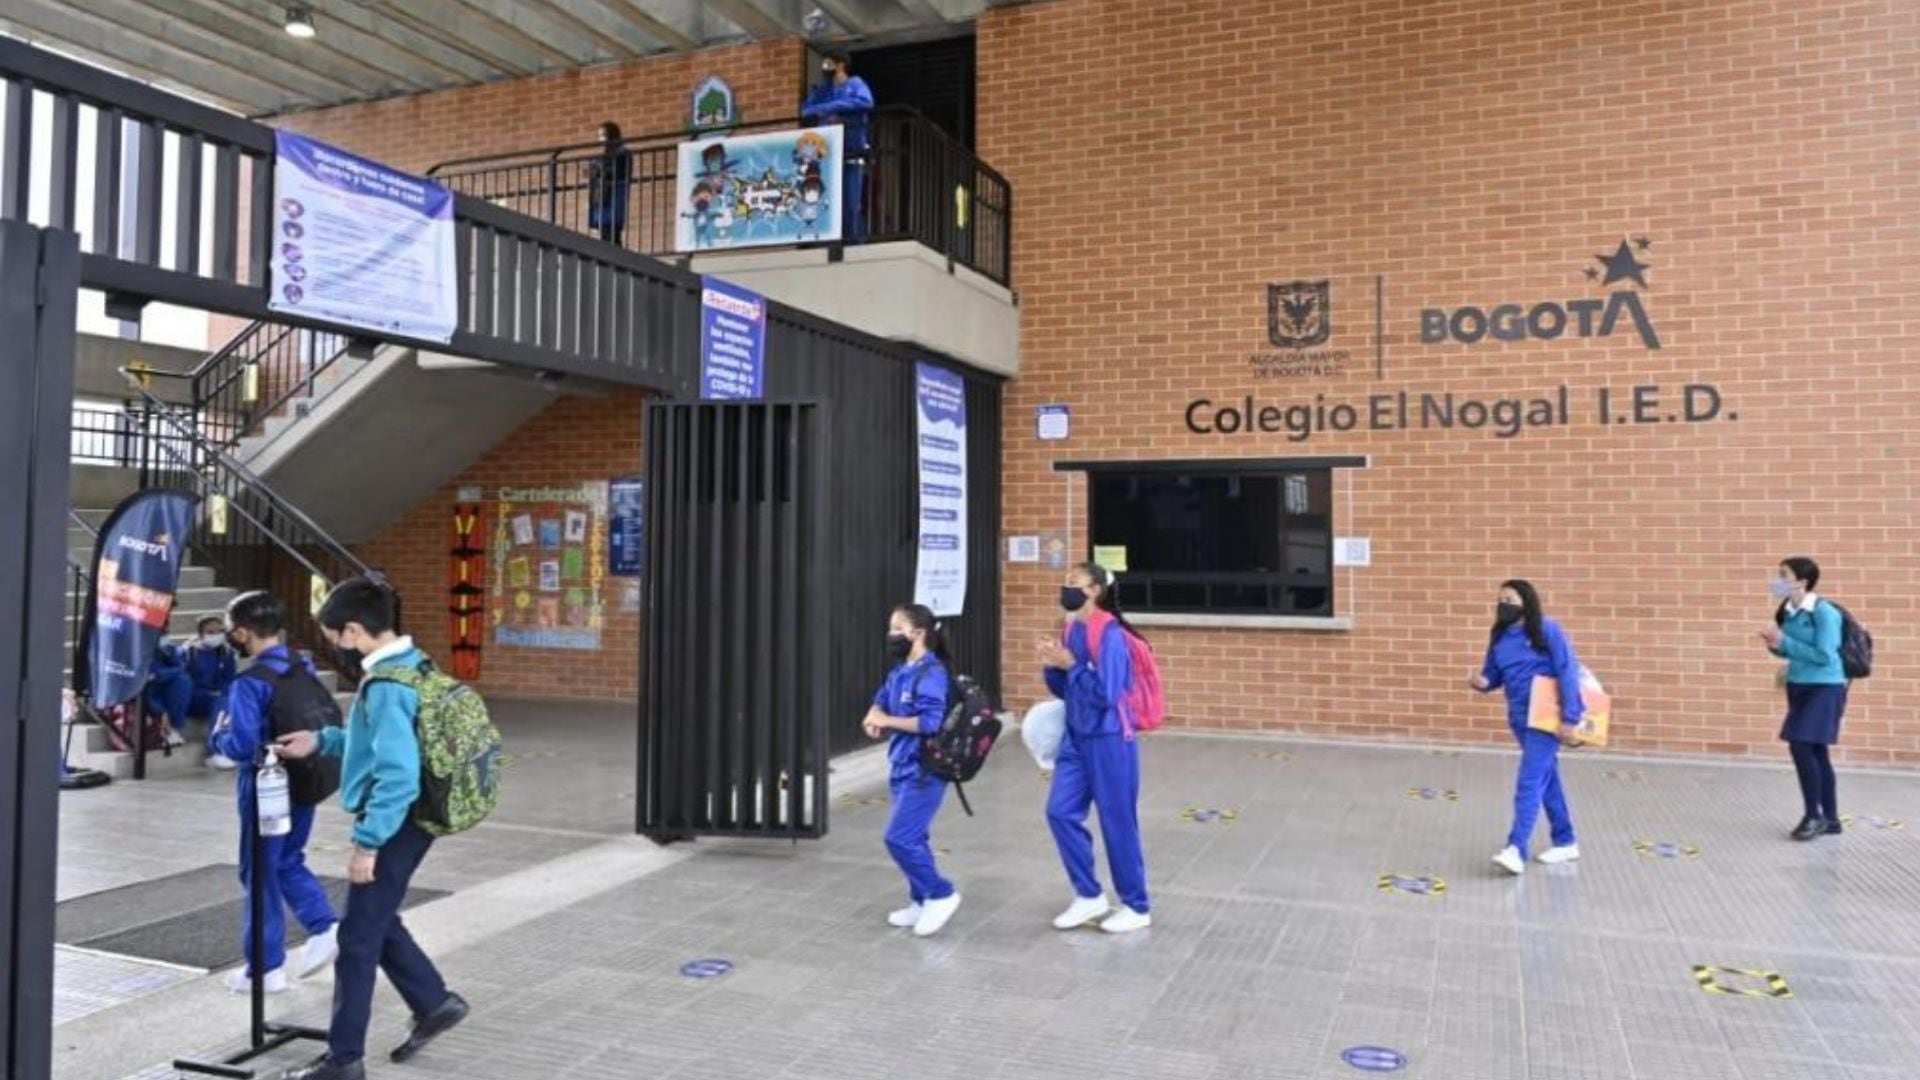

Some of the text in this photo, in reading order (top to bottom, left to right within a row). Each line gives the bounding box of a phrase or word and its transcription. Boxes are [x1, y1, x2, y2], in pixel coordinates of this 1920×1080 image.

[1184, 384, 1738, 442] Colegio El Nogal I.E.D.
